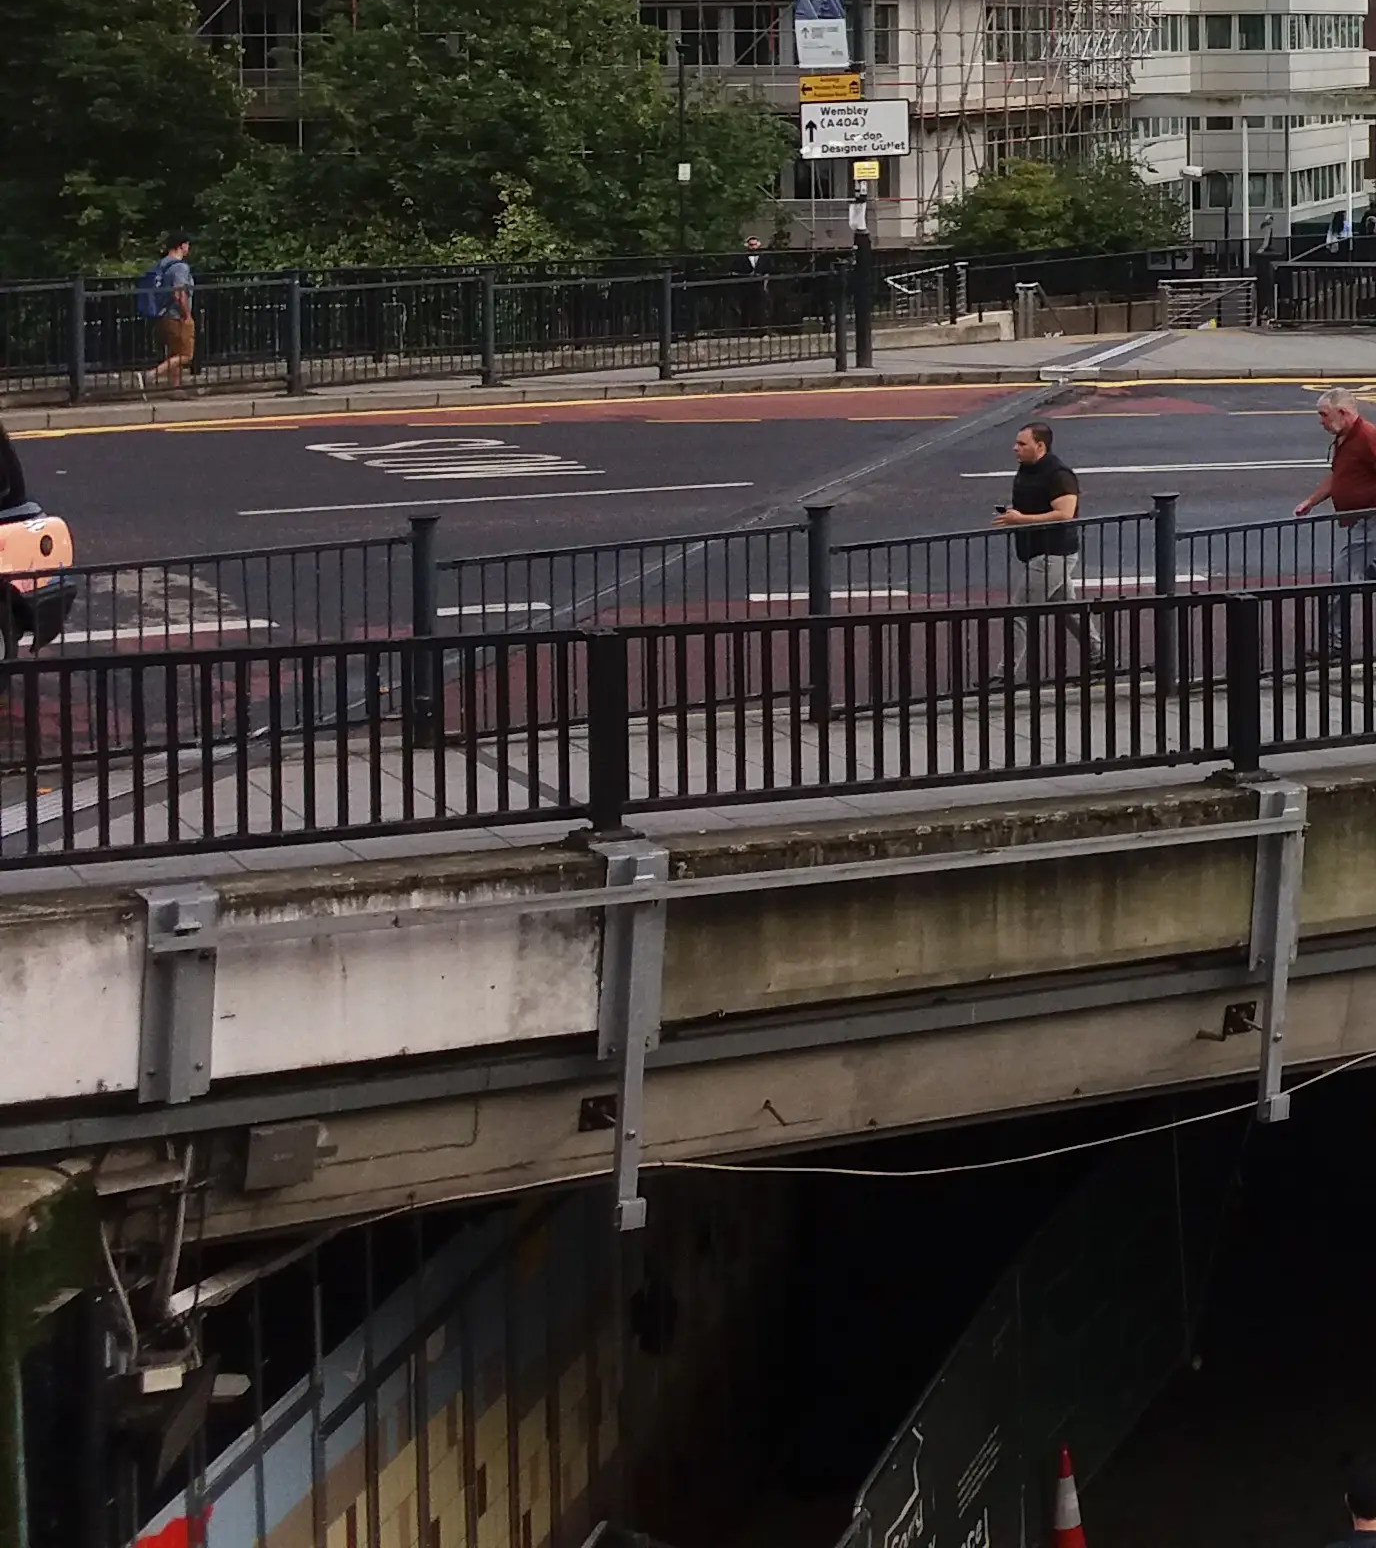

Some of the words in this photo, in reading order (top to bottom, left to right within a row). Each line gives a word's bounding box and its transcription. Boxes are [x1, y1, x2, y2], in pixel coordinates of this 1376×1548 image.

[820, 106, 868, 117] Wembley
[820, 118, 866, 128] (A404)
[844, 132, 882, 141] Lodon
[822, 144, 867, 154] Designer
